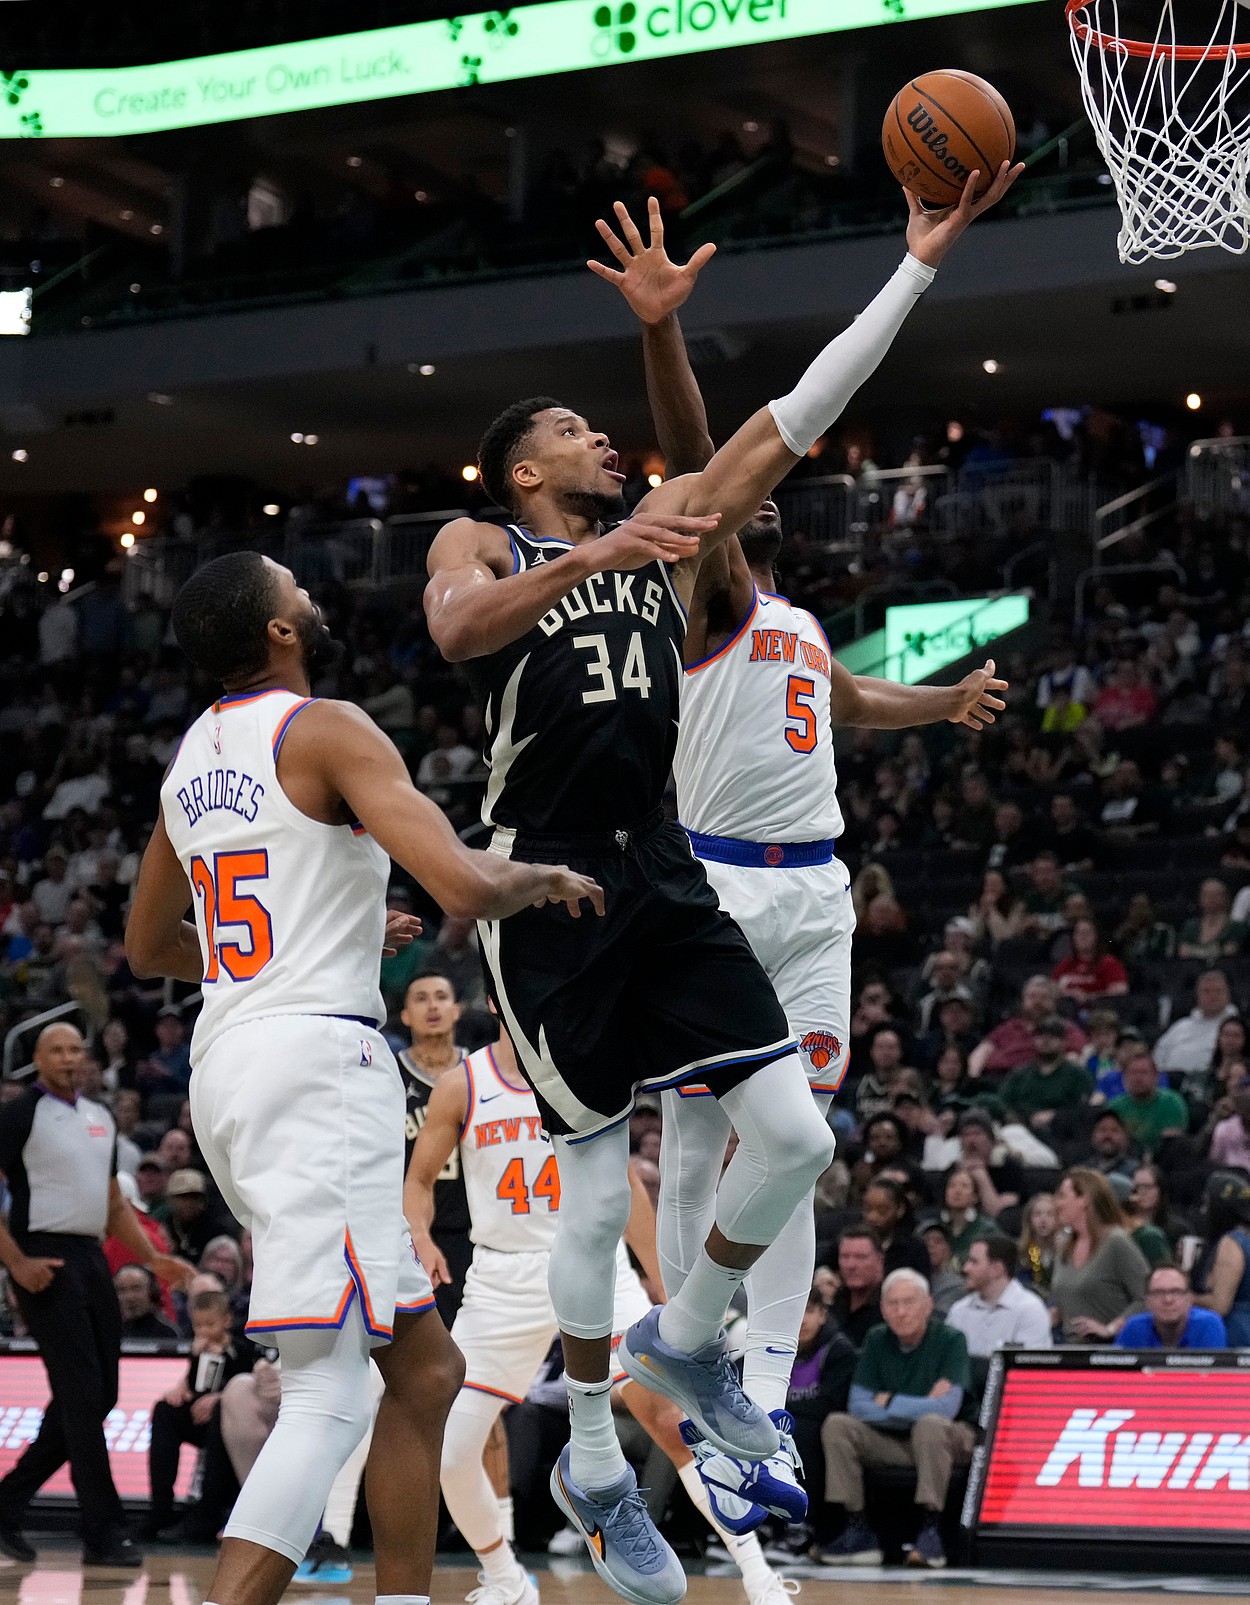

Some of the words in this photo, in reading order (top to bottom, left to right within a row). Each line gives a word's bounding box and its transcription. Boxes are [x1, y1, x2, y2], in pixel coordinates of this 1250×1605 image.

[93, 86, 188, 118] Create
[195, 74, 257, 103] Your
[265, 63, 331, 95] Own
[340, 50, 412, 83] Luck.
[907, 102, 970, 180] Wilson
[573, 631, 652, 704] 34
[749, 629, 798, 663] NEW
[799, 640, 832, 678] ORK
[784, 674, 818, 755] 5
[176, 769, 265, 828] BRIDGES
[190, 848, 274, 983] 25
[800, 1032, 840, 1059] KNICKS
[474, 1119, 521, 1149] NEW
[496, 1155, 562, 1215] 44
